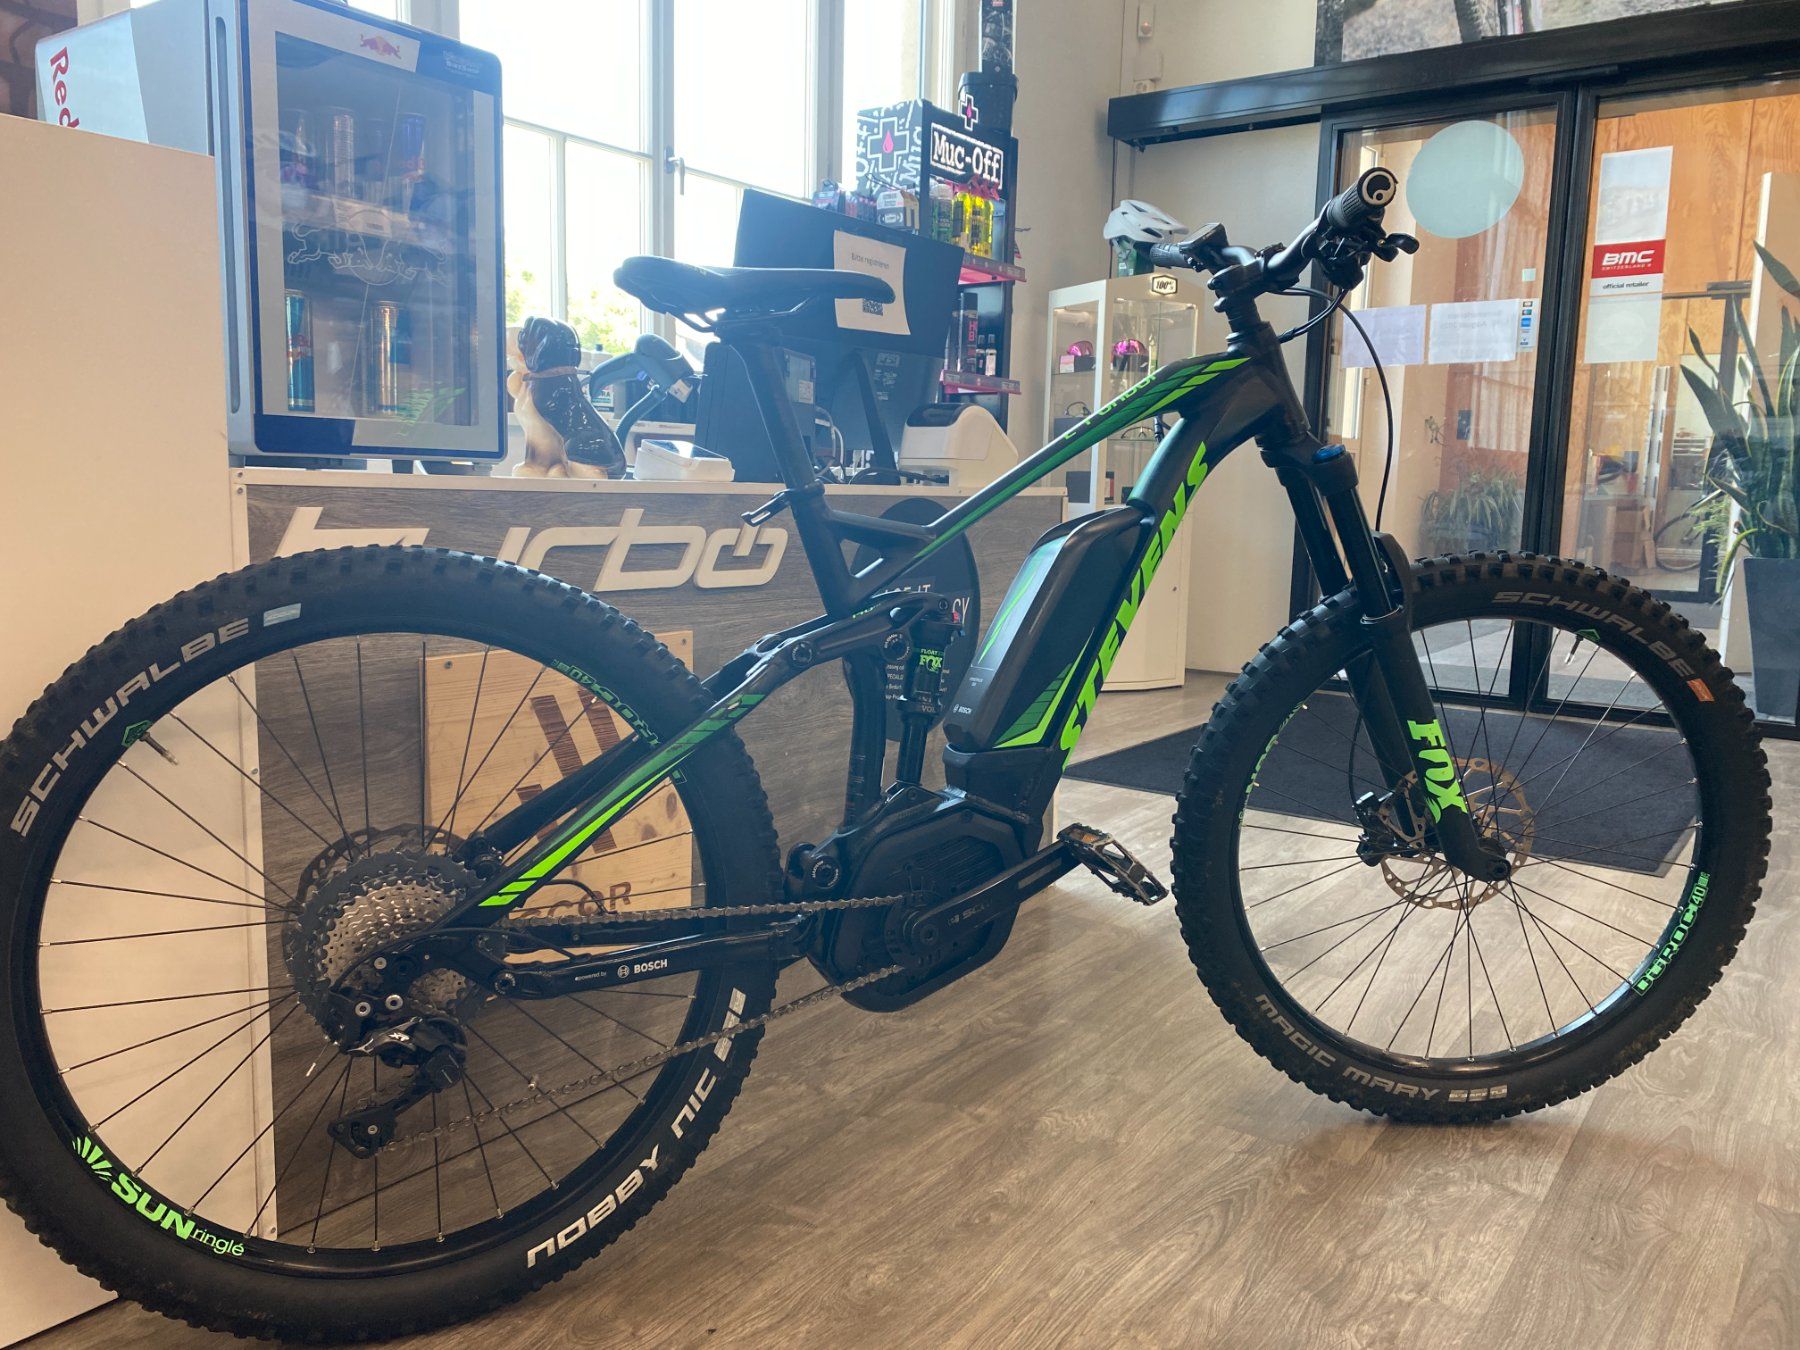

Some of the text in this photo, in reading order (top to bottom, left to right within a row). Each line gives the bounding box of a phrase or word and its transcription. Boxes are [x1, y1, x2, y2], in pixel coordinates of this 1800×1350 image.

[932, 130, 1001, 182] Muc-Off
[1602, 250, 1656, 266] BMC
[1060, 441, 1209, 773] STEVENS
[1491, 591, 1696, 678] SCHWALBE
[919, 654, 943, 673] FOX
[10, 617, 249, 838] SCHWALBE
[1407, 719, 1469, 824] FOX
[633, 958, 668, 974] BOSCH
[1255, 994, 1441, 1101] MAGIC MARY
[527, 1067, 717, 1269] NOBBY NIC
